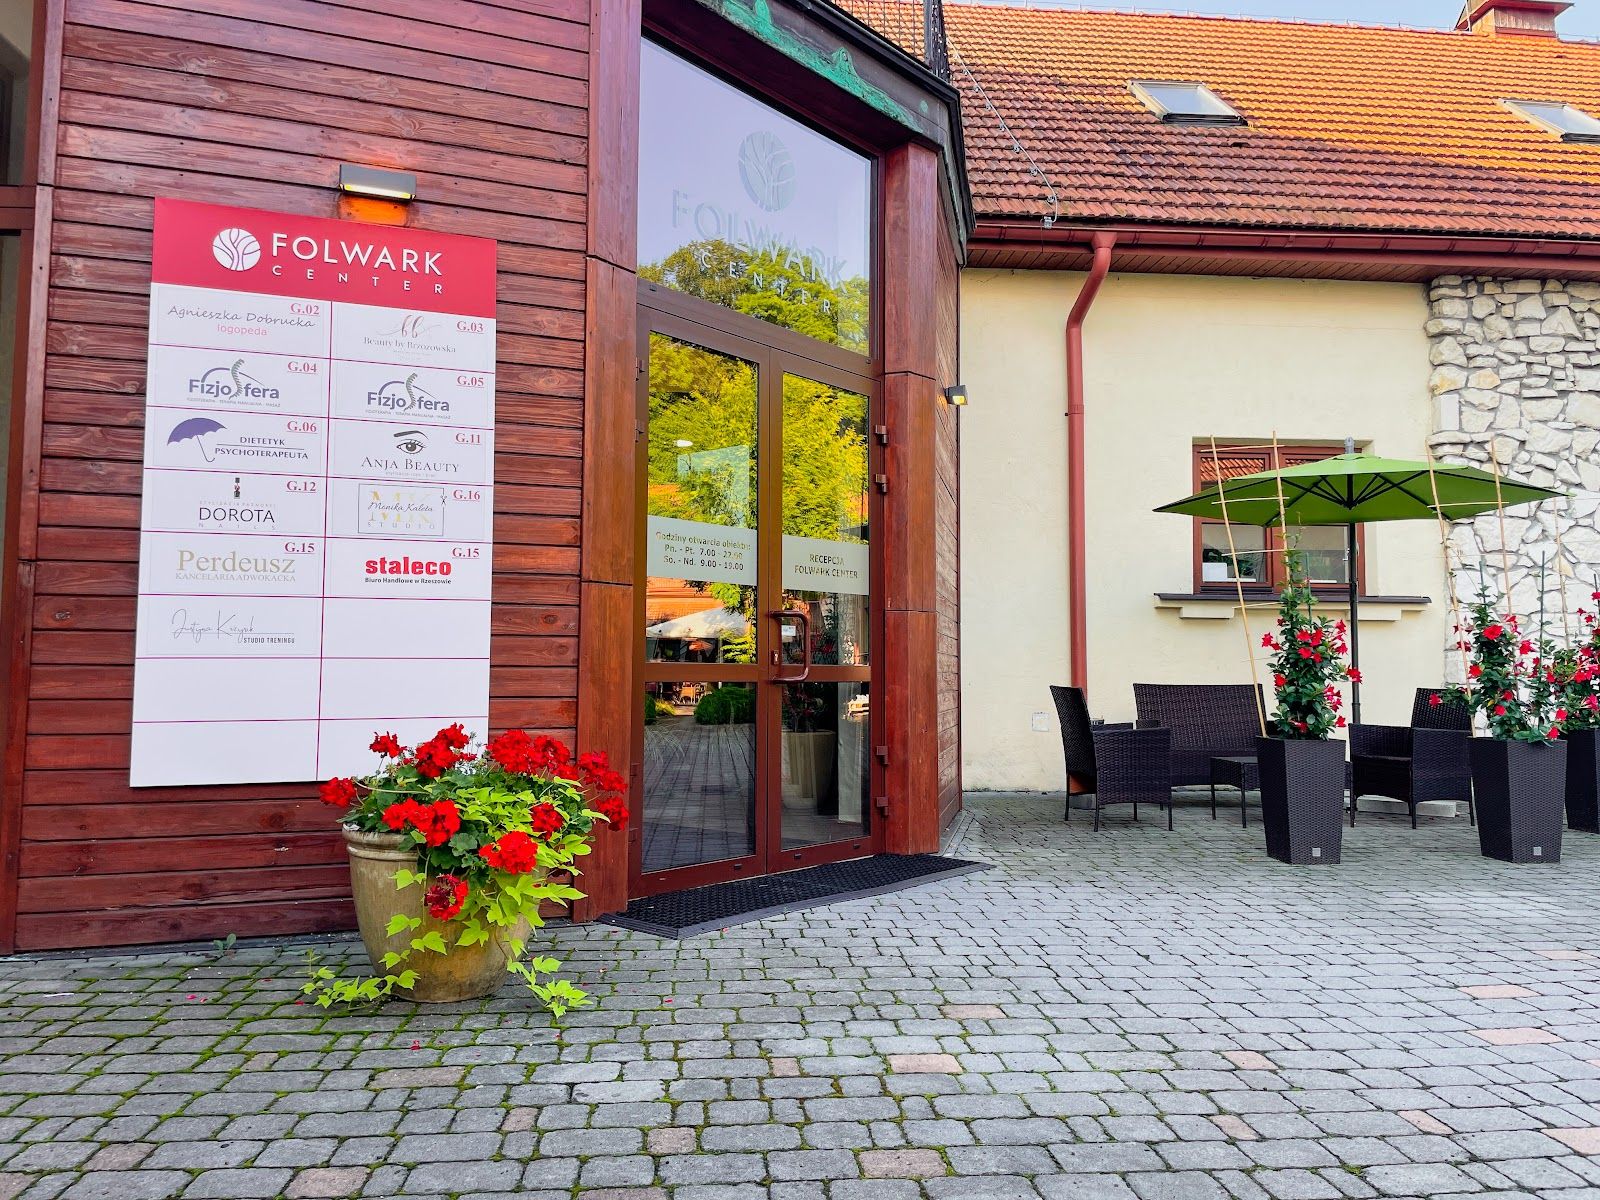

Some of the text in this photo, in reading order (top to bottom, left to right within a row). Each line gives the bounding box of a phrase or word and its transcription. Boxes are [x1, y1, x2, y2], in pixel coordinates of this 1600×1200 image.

[672, 188, 848, 294] FOLWARK
[272, 232, 443, 276] FOLWARK
[272, 265, 443, 294] CENTER
[697, 247, 832, 315] CENTER
[290, 303, 320, 316] G.02
[168, 305, 316, 328] Agnieszka Dobrucka
[217, 324, 268, 336] logopeda
[456, 320, 484, 332] G.03
[287, 360, 317, 373] G.04
[457, 375, 485, 387] G.05
[287, 420, 317, 433] G.06
[240, 436, 285, 446] DIETETYK
[455, 432, 481, 444] G.11
[215, 447, 309, 459] PSYCHOTERAPEUTA
[286, 480, 317, 492] G.12
[453, 489, 481, 500] G.16
[368, 502, 403, 512] Monika
[199, 507, 275, 523] DOROTA
[284, 541, 315, 553] G.15
[452, 547, 480, 558] G.15
[664, 544, 677, 553] Pn.
[685, 546, 695, 554] Pt.
[700, 548, 716, 556] 7.00
[176, 549, 296, 573] Perdeusz
[365, 556, 452, 576] staleco
[664, 555, 676, 564] So.
[700, 559, 717, 568] 9.00
[175, 572, 296, 582] KANCELARIA ADWOKACKA
[832, 568, 858, 579] CENTER
